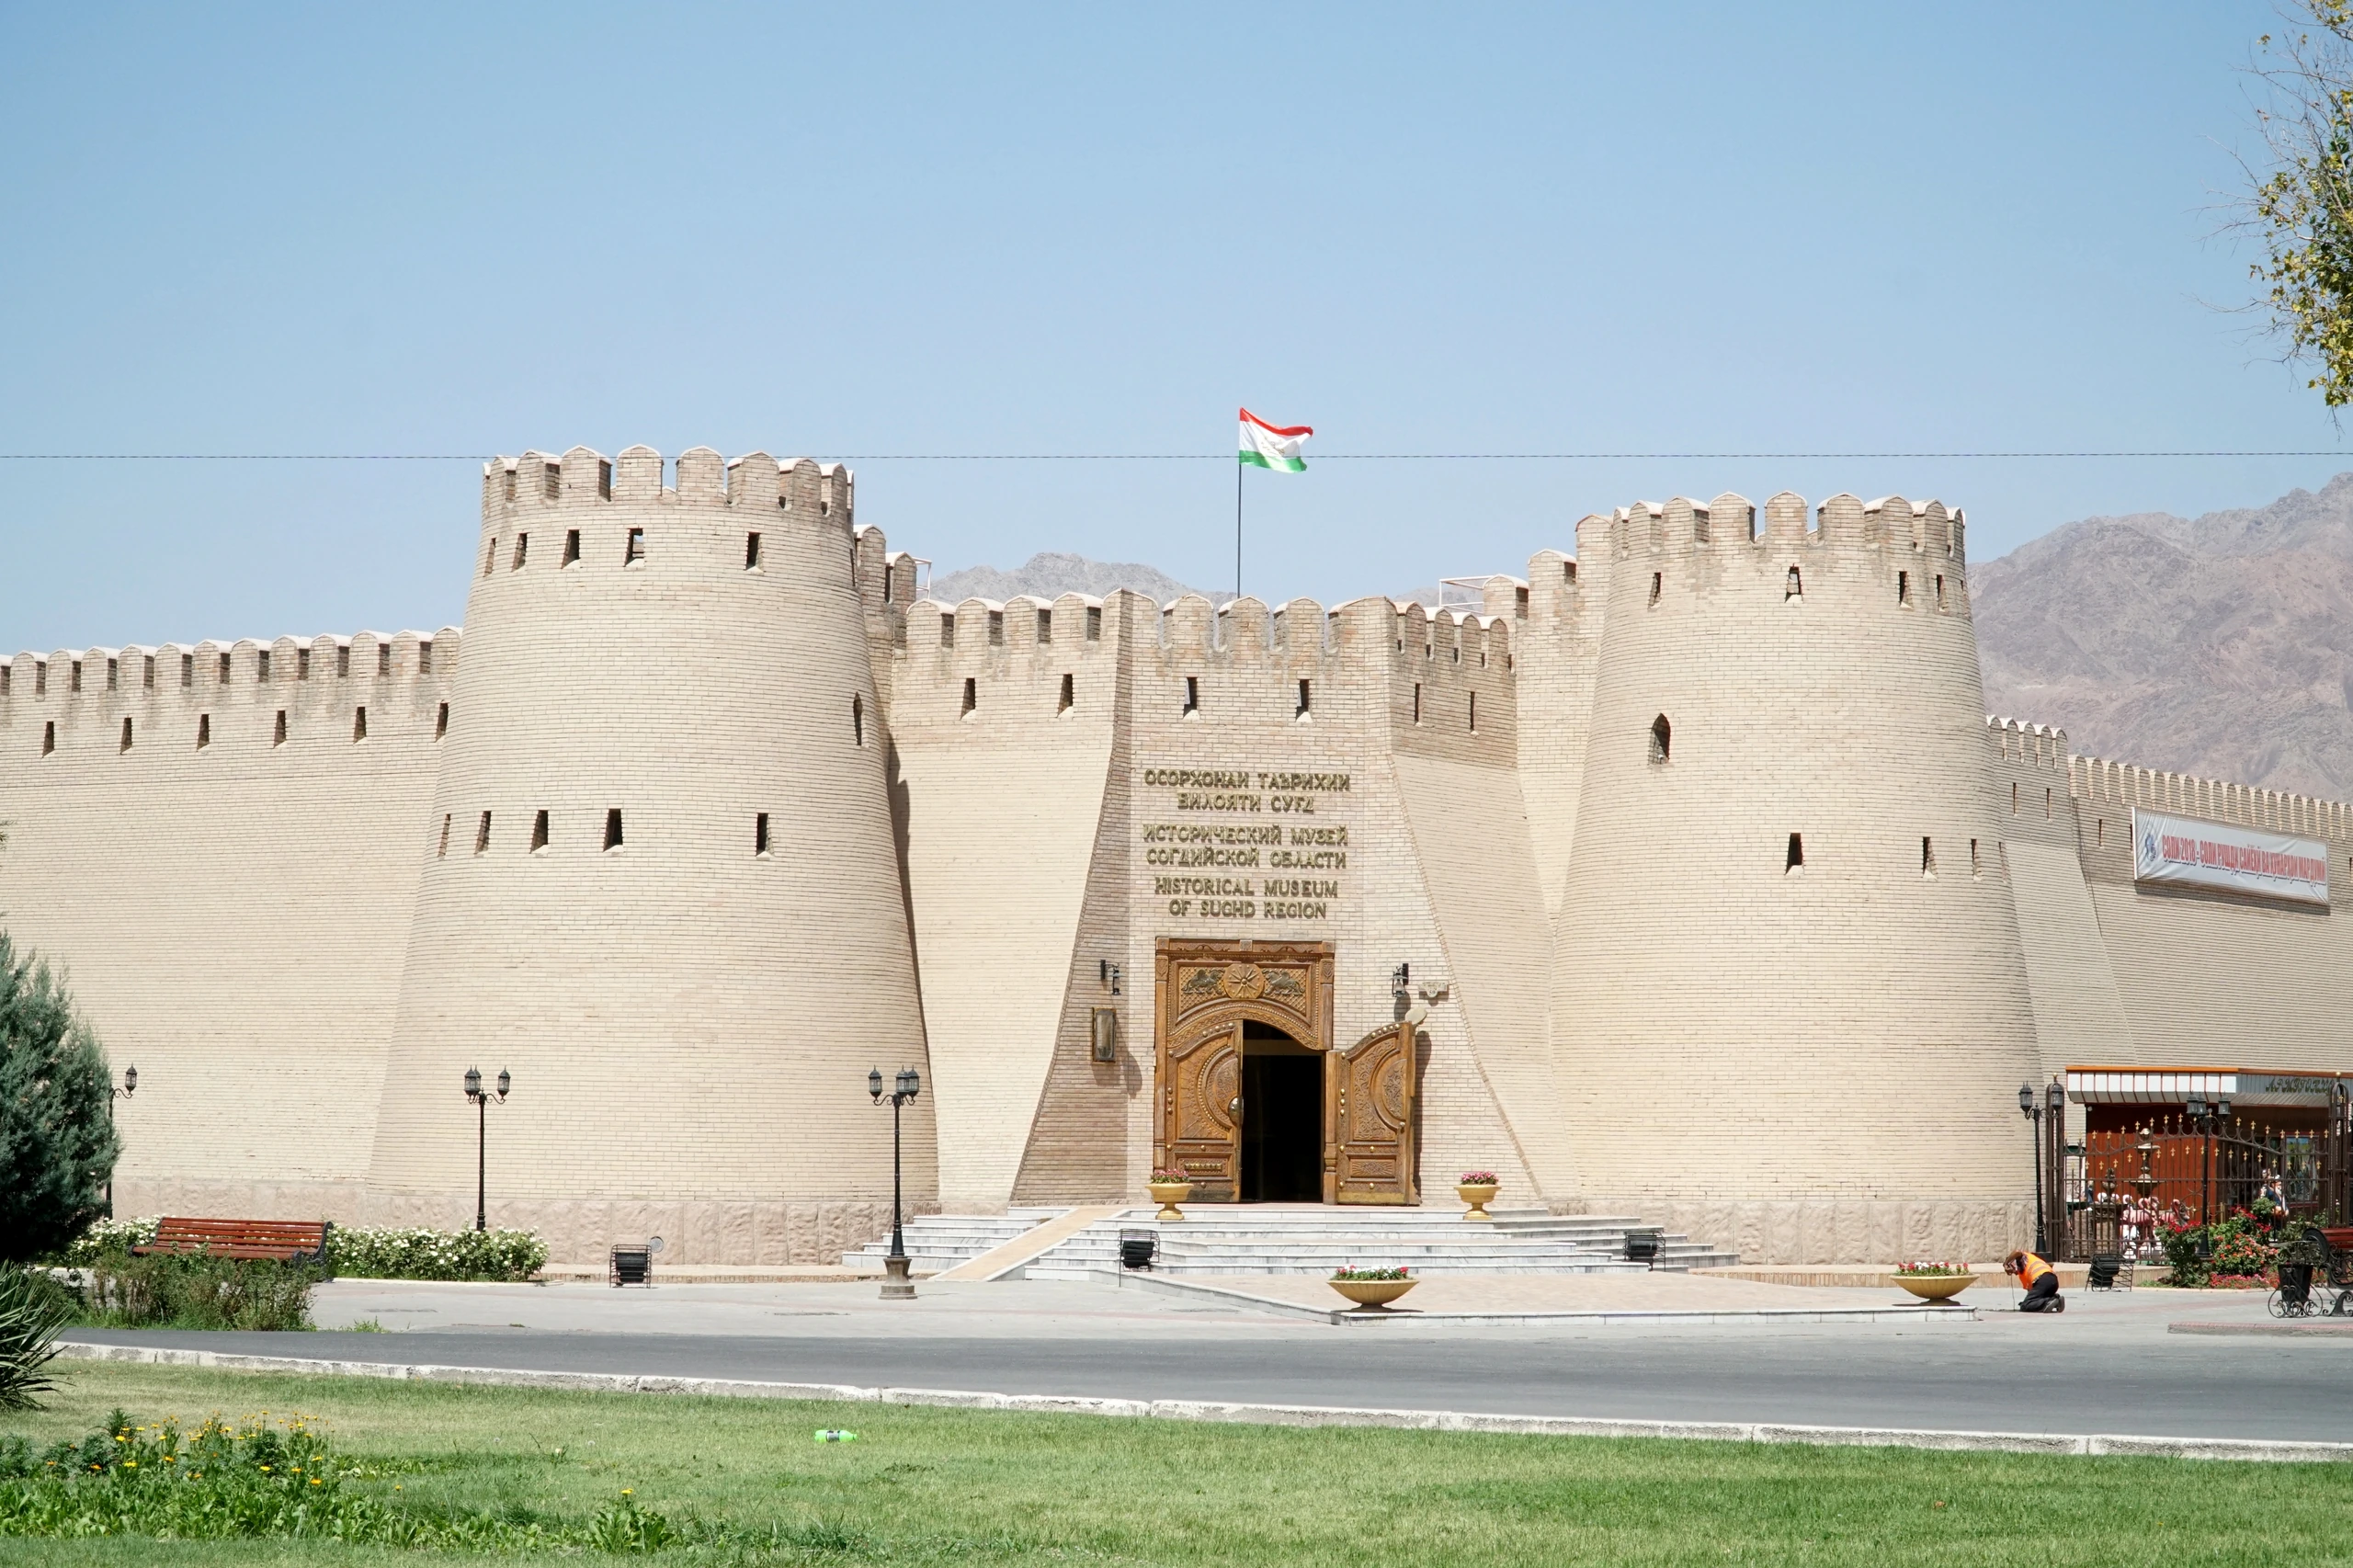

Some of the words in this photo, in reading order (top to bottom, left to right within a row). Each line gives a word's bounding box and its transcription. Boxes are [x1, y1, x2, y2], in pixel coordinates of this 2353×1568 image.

[1144, 768, 1249, 789] ОСОРХОНАИ
[1177, 792, 1261, 812] ВИЛОЯТИ
[1142, 824, 1282, 845] ИСТОРИЧЕСКИЙ
[1290, 824, 1348, 846] МУЗЕЙ
[1146, 846, 1259, 867] СОГДИЙСКОЙ
[1269, 850, 1347, 869] ОБЛАСТИ
[1154, 877, 1255, 896] HISTORICAL
[1264, 879, 1338, 898] MUSEUM
[1169, 899, 1191, 916] OF
[1200, 900, 1256, 918] SUGHD
[1264, 901, 1326, 919] REGION
